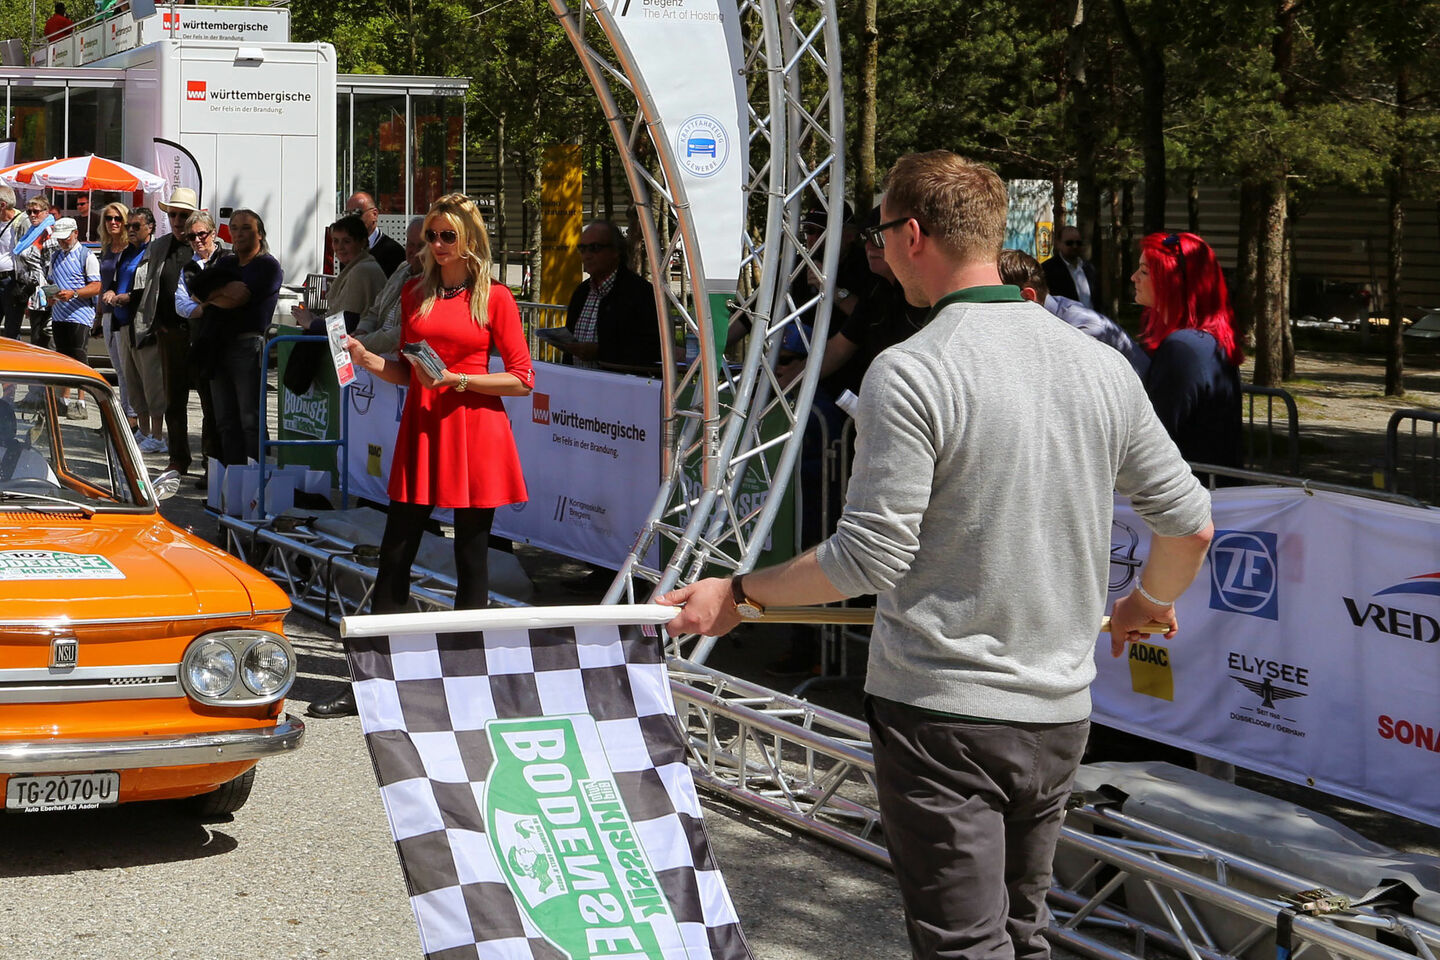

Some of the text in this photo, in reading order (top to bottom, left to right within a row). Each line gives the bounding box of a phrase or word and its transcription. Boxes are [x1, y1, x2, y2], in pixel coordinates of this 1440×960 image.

[643, 8, 725, 23] The Art of Hosting
[182, 20, 269, 32] württembergische
[210, 89, 312, 103] württembergische
[686, 160, 717, 172] GEWERBE
[551, 410, 646, 441] württembergische
[574, 437, 579, 447] in
[580, 439, 590, 450] der
[1220, 545, 1270, 597] ZF
[57, 644, 75, 662] NSU
[1129, 642, 1168, 667] ADAC
[1227, 651, 1309, 687] ELYSEE
